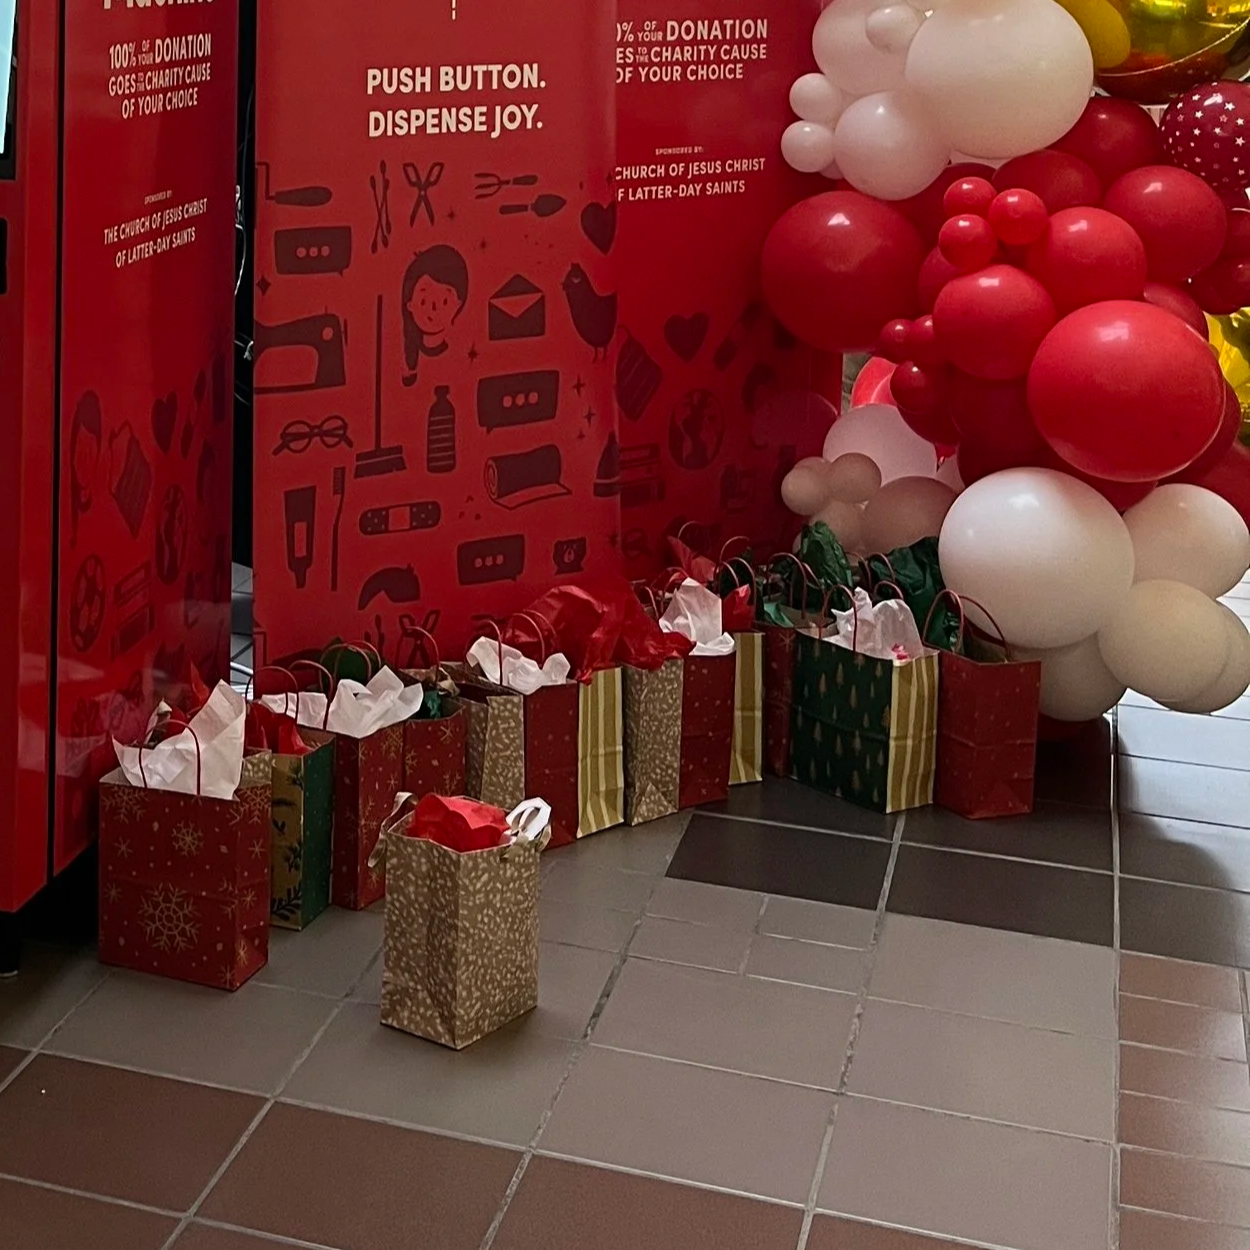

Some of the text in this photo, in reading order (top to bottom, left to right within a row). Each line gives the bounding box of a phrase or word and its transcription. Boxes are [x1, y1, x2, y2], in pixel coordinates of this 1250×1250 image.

[637, 31, 663, 42] YOUR
[643, 18, 768, 42] OF DONATION
[109, 39, 150, 70] 100% OF
[137, 33, 212, 66] YOUR DONATION
[616, 43, 767, 64] ES TO CHARITY CAUSE
[109, 73, 137, 97] GOES
[145, 66, 185, 91] CHARITY
[185, 62, 211, 84] CAUSE
[367, 62, 546, 95] PUSH BUTTON.
[638, 66, 682, 83] YOUR
[686, 63, 744, 82] CHOICE
[121, 87, 198, 119] OF YOUR CHOICE
[368, 103, 543, 139] DISPENSE JOY.
[615, 157, 766, 181] CHURCH OF JESUS CHRIST
[628, 182, 703, 201] LATTER-DAY
[705, 179, 746, 196] SAINTS
[104, 198, 208, 245] THE CHURCH OF JESUS CHRIST
[115, 227, 196, 269] OF LATTER-DAY SAINTS
